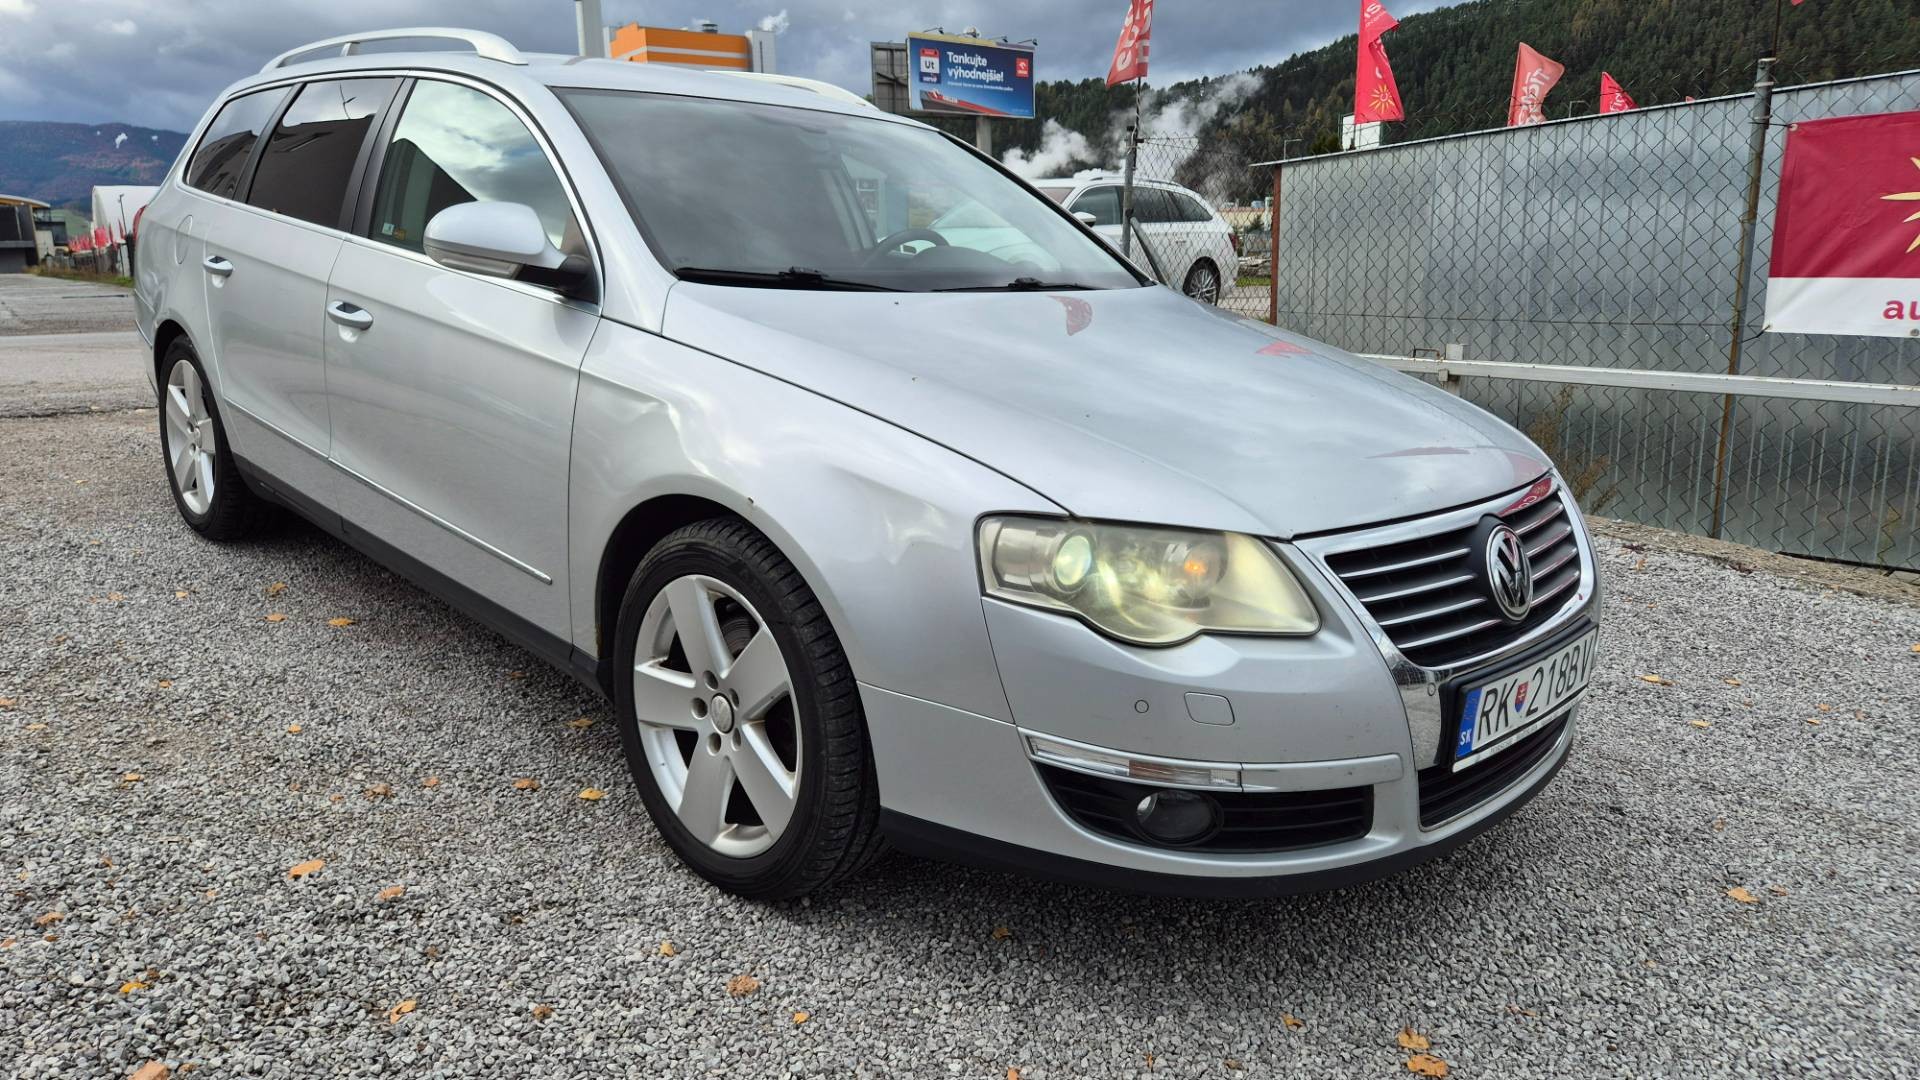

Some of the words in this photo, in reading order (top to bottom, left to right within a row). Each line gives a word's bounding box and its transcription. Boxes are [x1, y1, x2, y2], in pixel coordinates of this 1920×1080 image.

[924, 60, 935, 70] Ut
[946, 51, 988, 67] Tankujte
[947, 67, 1004, 82] výhodnejšie!
[1459, 727, 1472, 746] SK
